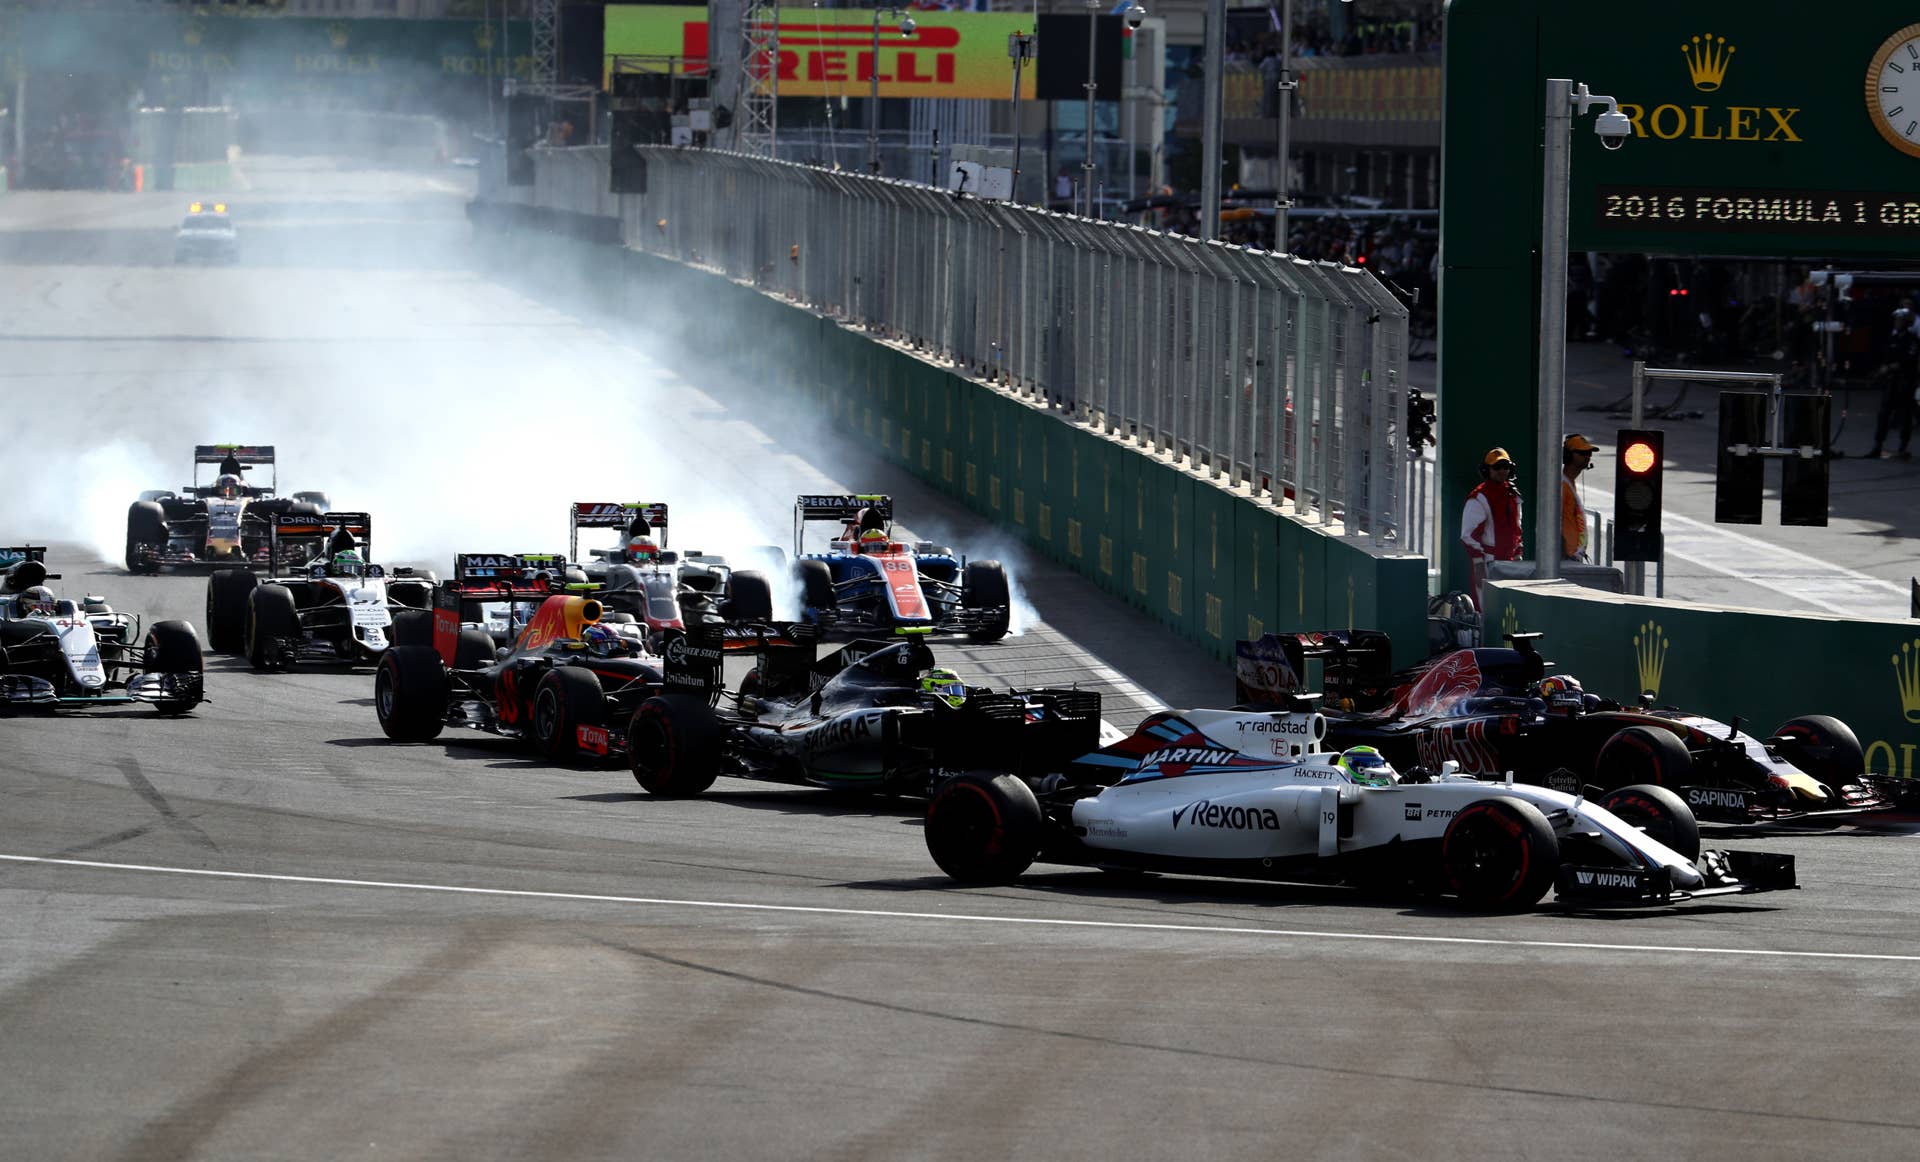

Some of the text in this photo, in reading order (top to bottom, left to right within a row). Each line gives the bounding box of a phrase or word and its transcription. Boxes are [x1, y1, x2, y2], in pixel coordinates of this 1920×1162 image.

[682, 21, 960, 84] PRELLI
[1616, 103, 1804, 142] ROLEX
[1605, 195, 1687, 220] 2016
[1696, 197, 1842, 223] FORMULA
[1853, 201, 1868, 223] 1
[886, 562, 910, 571] 88
[701, 647, 721, 659] STATE
[803, 716, 872, 752] SAHARA
[1252, 718, 1308, 735] randstad
[581, 727, 608, 746] TOTAL
[1138, 748, 1236, 770] MARTINI
[1294, 767, 1335, 780] HACKETT
[1688, 789, 1746, 808] SAPINDA
[1190, 800, 1281, 831] Rexona
[1323, 811, 1336, 825] 19
[1597, 873, 1638, 888] WIPAK
